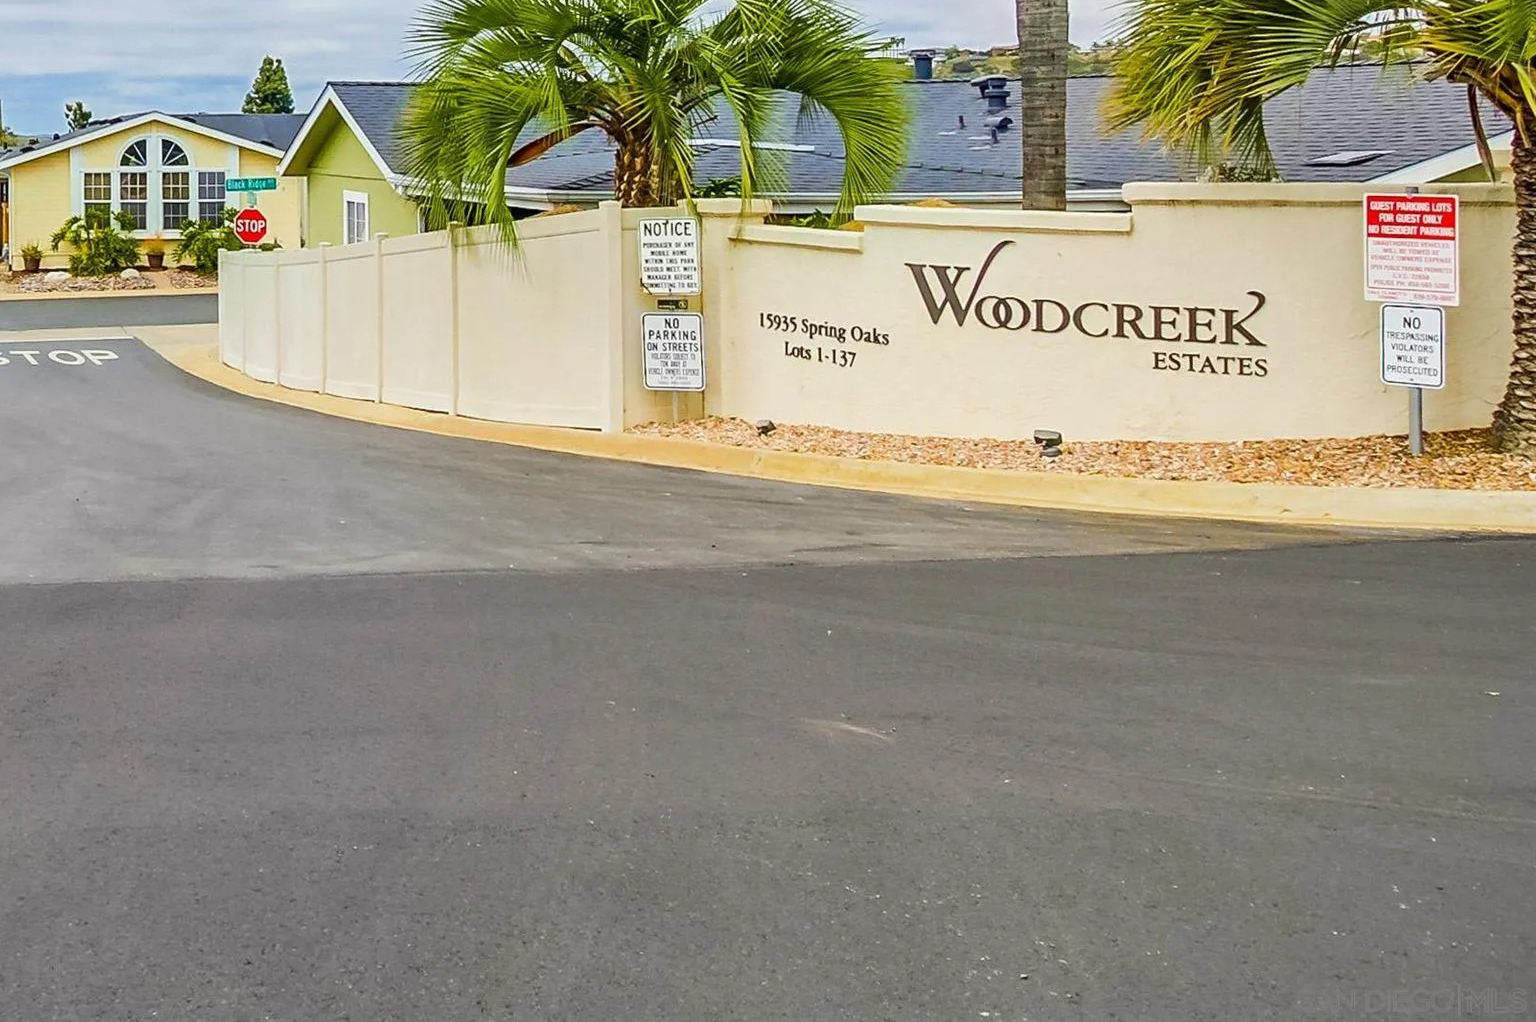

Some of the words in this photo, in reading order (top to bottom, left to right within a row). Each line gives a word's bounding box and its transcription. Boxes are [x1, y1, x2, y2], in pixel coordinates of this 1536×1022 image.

[1369, 201, 1395, 211] GUEST
[1396, 201, 1430, 212] PARKING
[1431, 202, 1452, 213] LOTS
[1379, 213, 1395, 223] FOR
[1396, 213, 1421, 223] GUEST
[1422, 214, 1443, 225] ONLY
[237, 219, 265, 233] STOP
[644, 220, 692, 237] NOTICE
[1368, 225, 1380, 234] NO
[1381, 225, 1418, 236] RESIDENT
[1419, 227, 1454, 237] PARKING
[904, 240, 1267, 347] WOODCREEK
[664, 317, 680, 329] NO
[1403, 316, 1421, 329] NO
[648, 329, 697, 341] PARKING
[760, 312, 797, 333] 15935
[801, 318, 846, 343] Spring
[850, 325, 890, 346] Oaks
[1386, 331, 1439, 343] TRESPASSING
[647, 342, 658, 352] ON
[661, 342, 699, 353] STREETS
[1390, 342, 1434, 354] VIOLATORS
[784, 341, 812, 360] Lots
[818, 347, 856, 367] 1-137
[1396, 354, 1414, 364] WILL
[1417, 355, 1429, 365] BE
[1152, 351, 1268, 377] ESTATES
[1386, 364, 1439, 377] PROSECUTED
